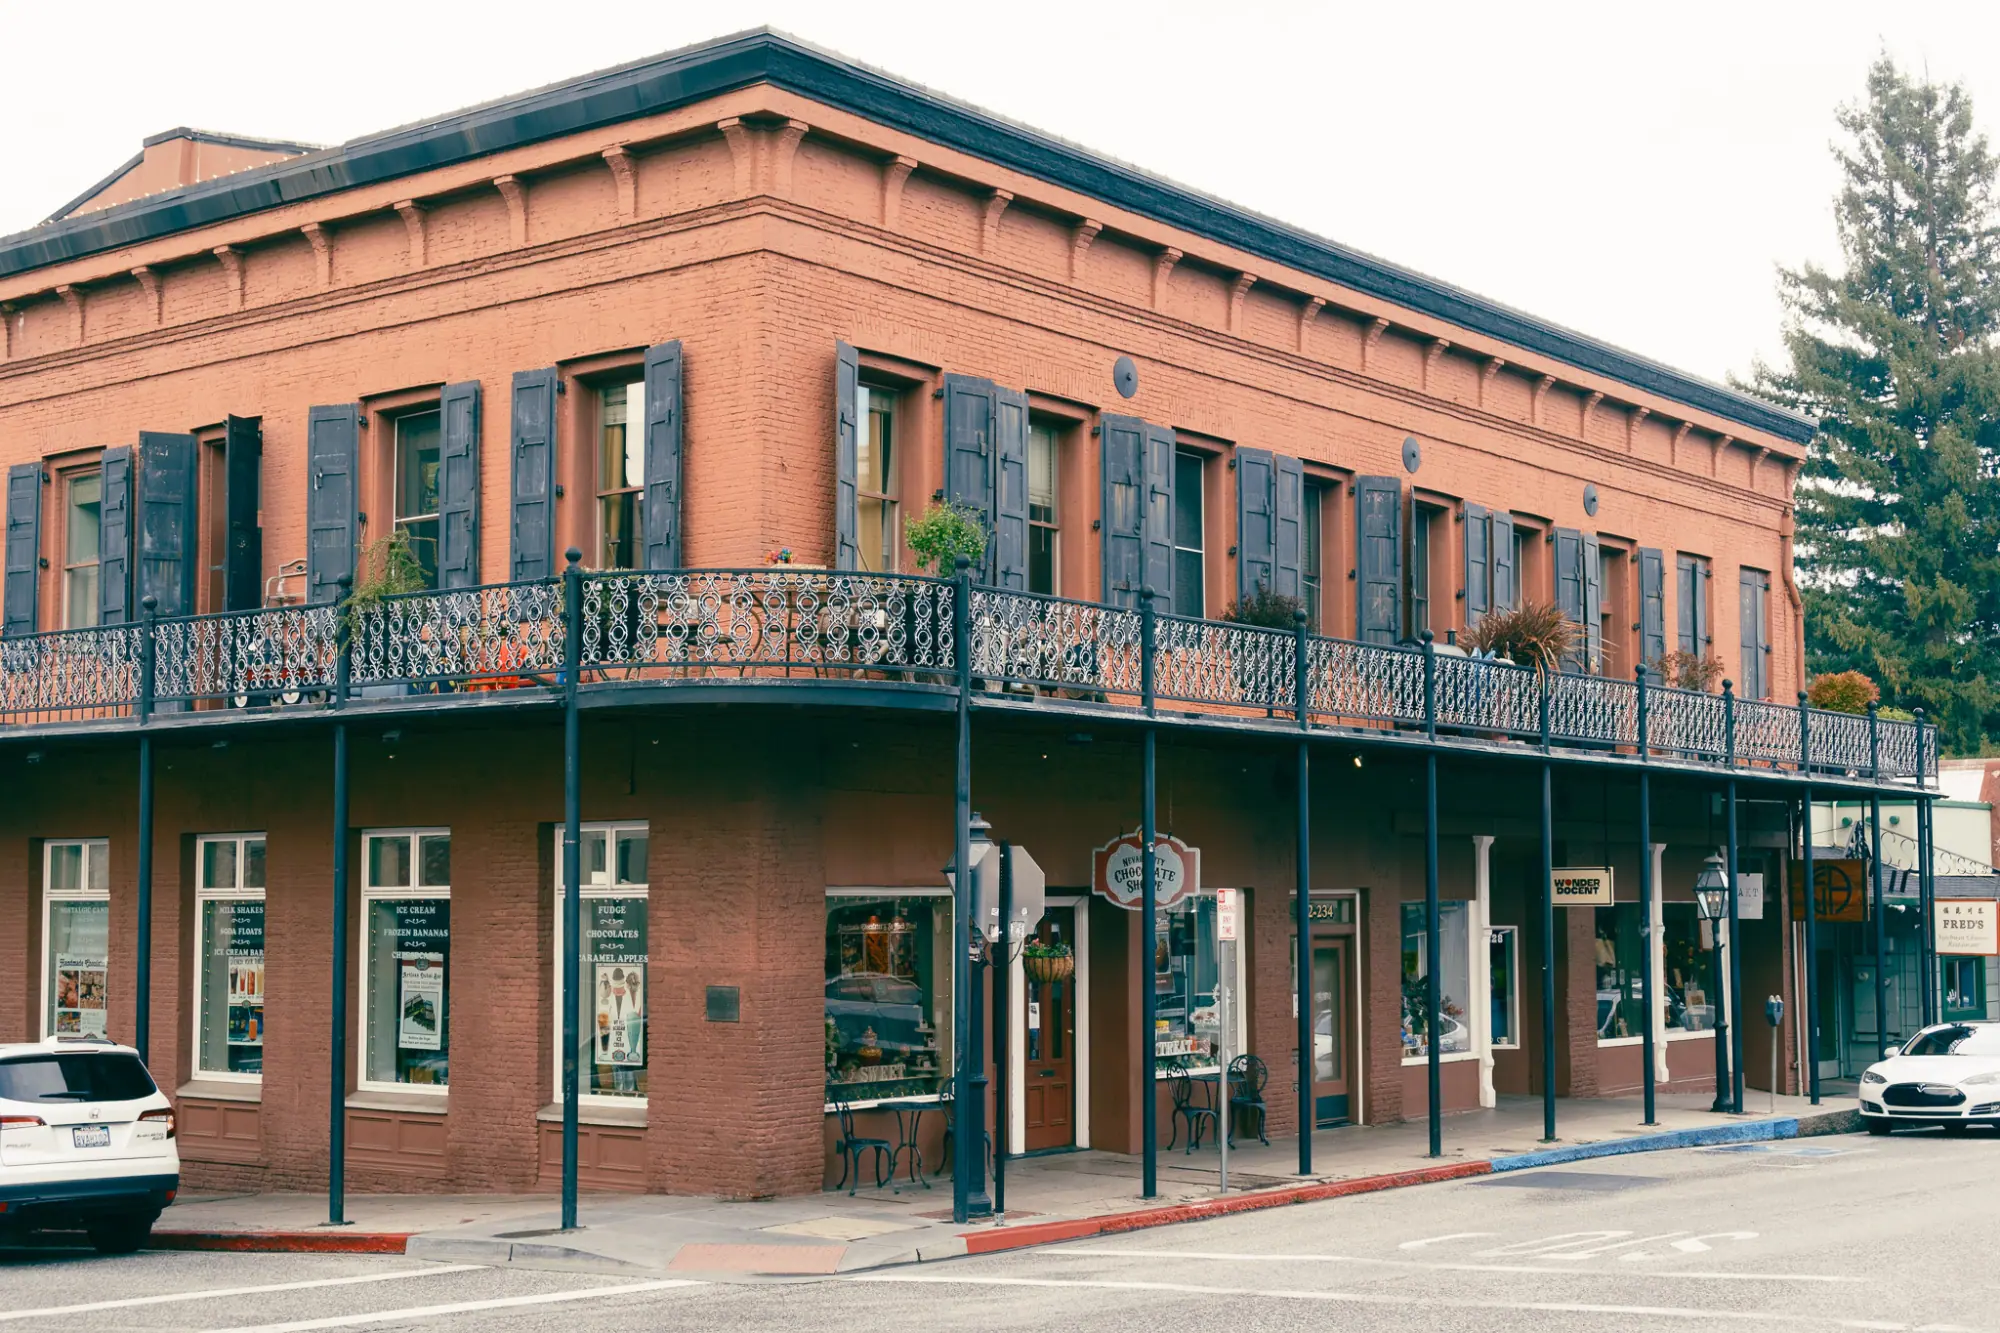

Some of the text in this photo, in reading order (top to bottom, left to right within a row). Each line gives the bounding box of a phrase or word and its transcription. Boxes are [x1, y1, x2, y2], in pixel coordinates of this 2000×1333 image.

[1122, 855, 1143, 867] NEVA
[1114, 866, 1176, 884] CHOCATE
[1554, 878, 1600, 888] WONDER
[1556, 886, 1599, 895] DOCENT
[220, 906, 264, 914] MILK SHAKES
[396, 906, 436, 914] ICE CREAM
[598, 905, 627, 915] FUDGE
[1942, 919, 1984, 930] FRED'S
[220, 928, 262, 936] SODA FLOATS
[383, 928, 449, 938] FROZEN BANANAS
[586, 929, 639, 939] CHOCOLATES
[225, 948, 249, 957] CREAM
[617, 954, 649, 964] APPLES
[860, 1064, 906, 1082] SWEET
